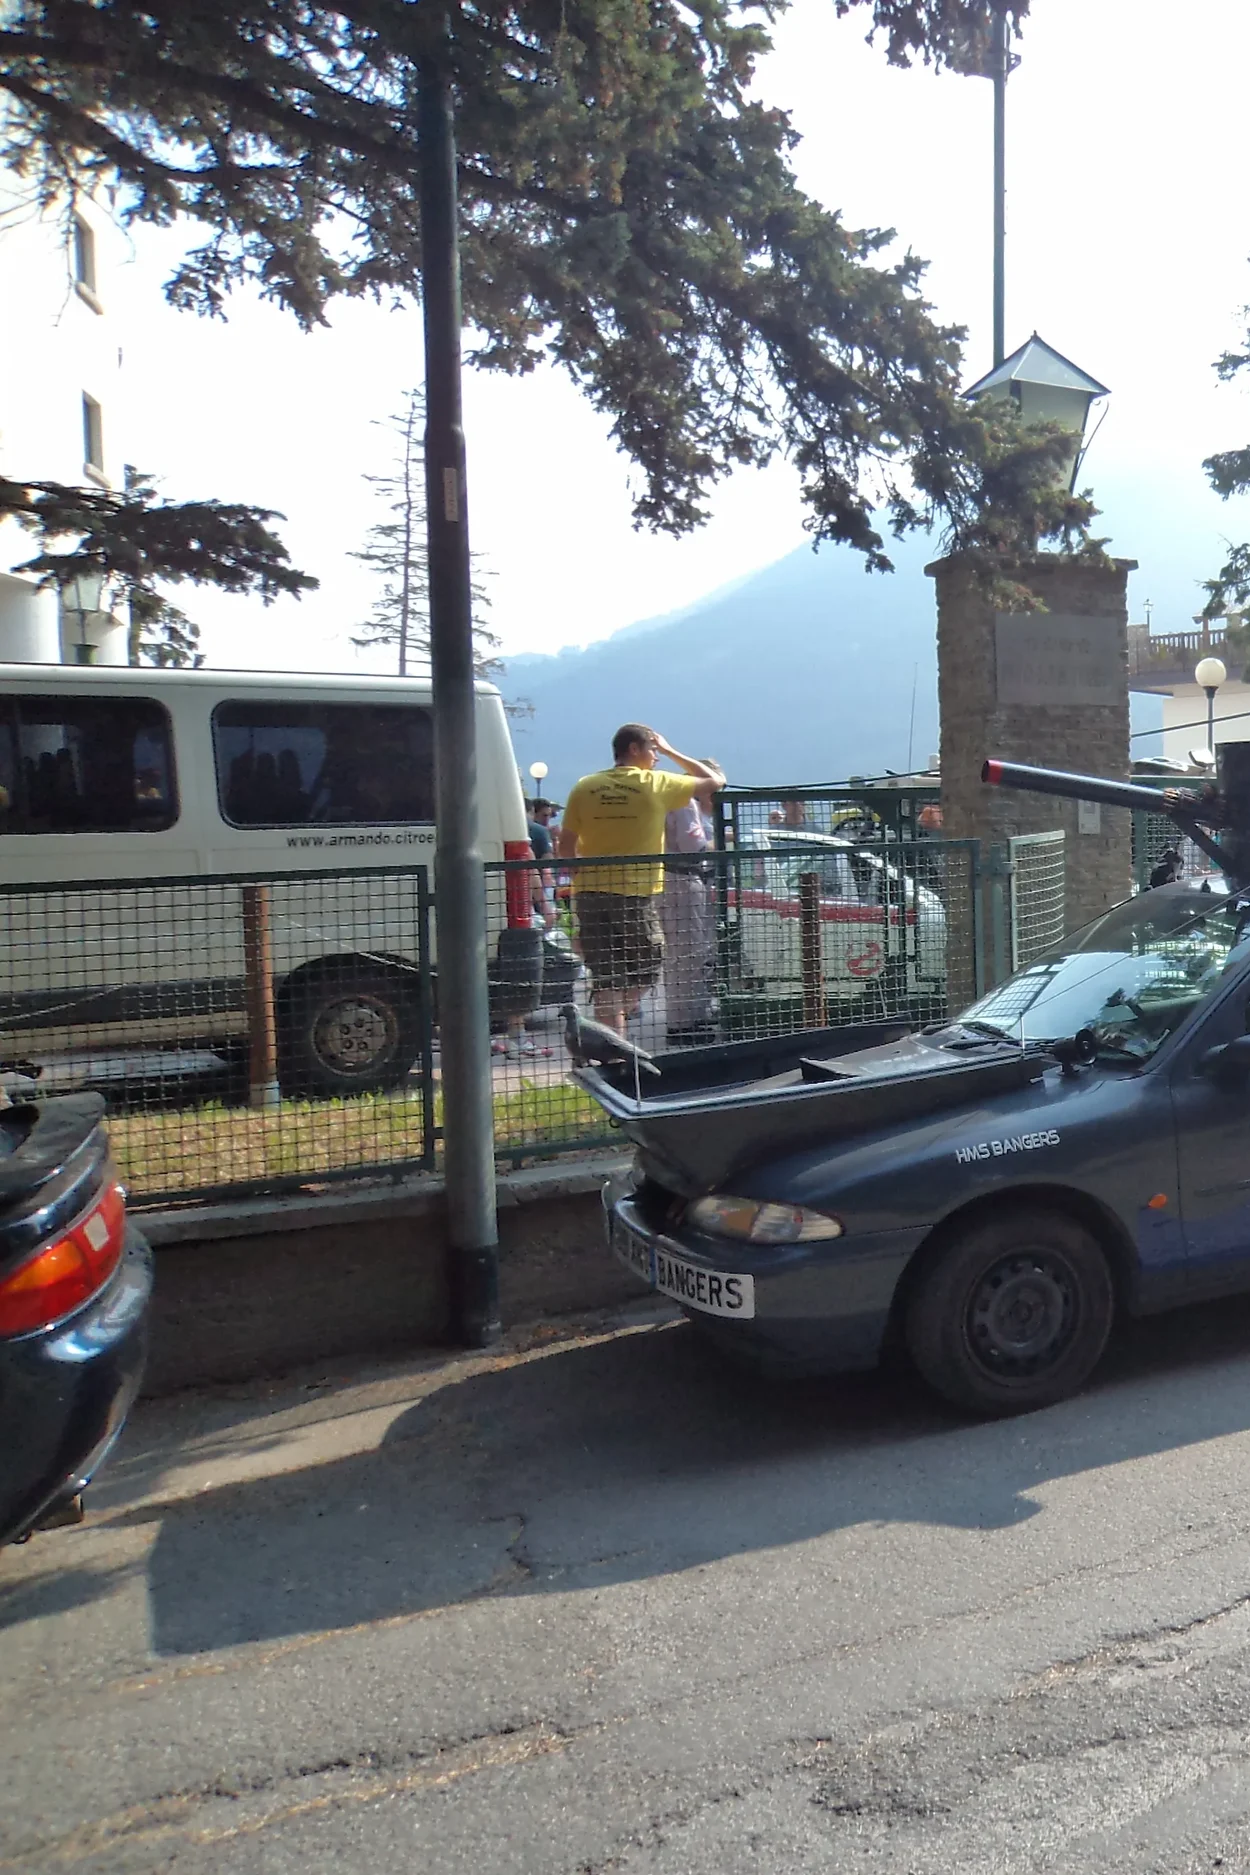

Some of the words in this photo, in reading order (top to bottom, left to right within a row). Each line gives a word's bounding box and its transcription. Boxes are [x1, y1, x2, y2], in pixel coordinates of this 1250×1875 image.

[956, 1143, 991, 1164] HMS
[991, 1129, 1061, 1157] BANGERS
[657, 1253, 744, 1310] BANGERS
